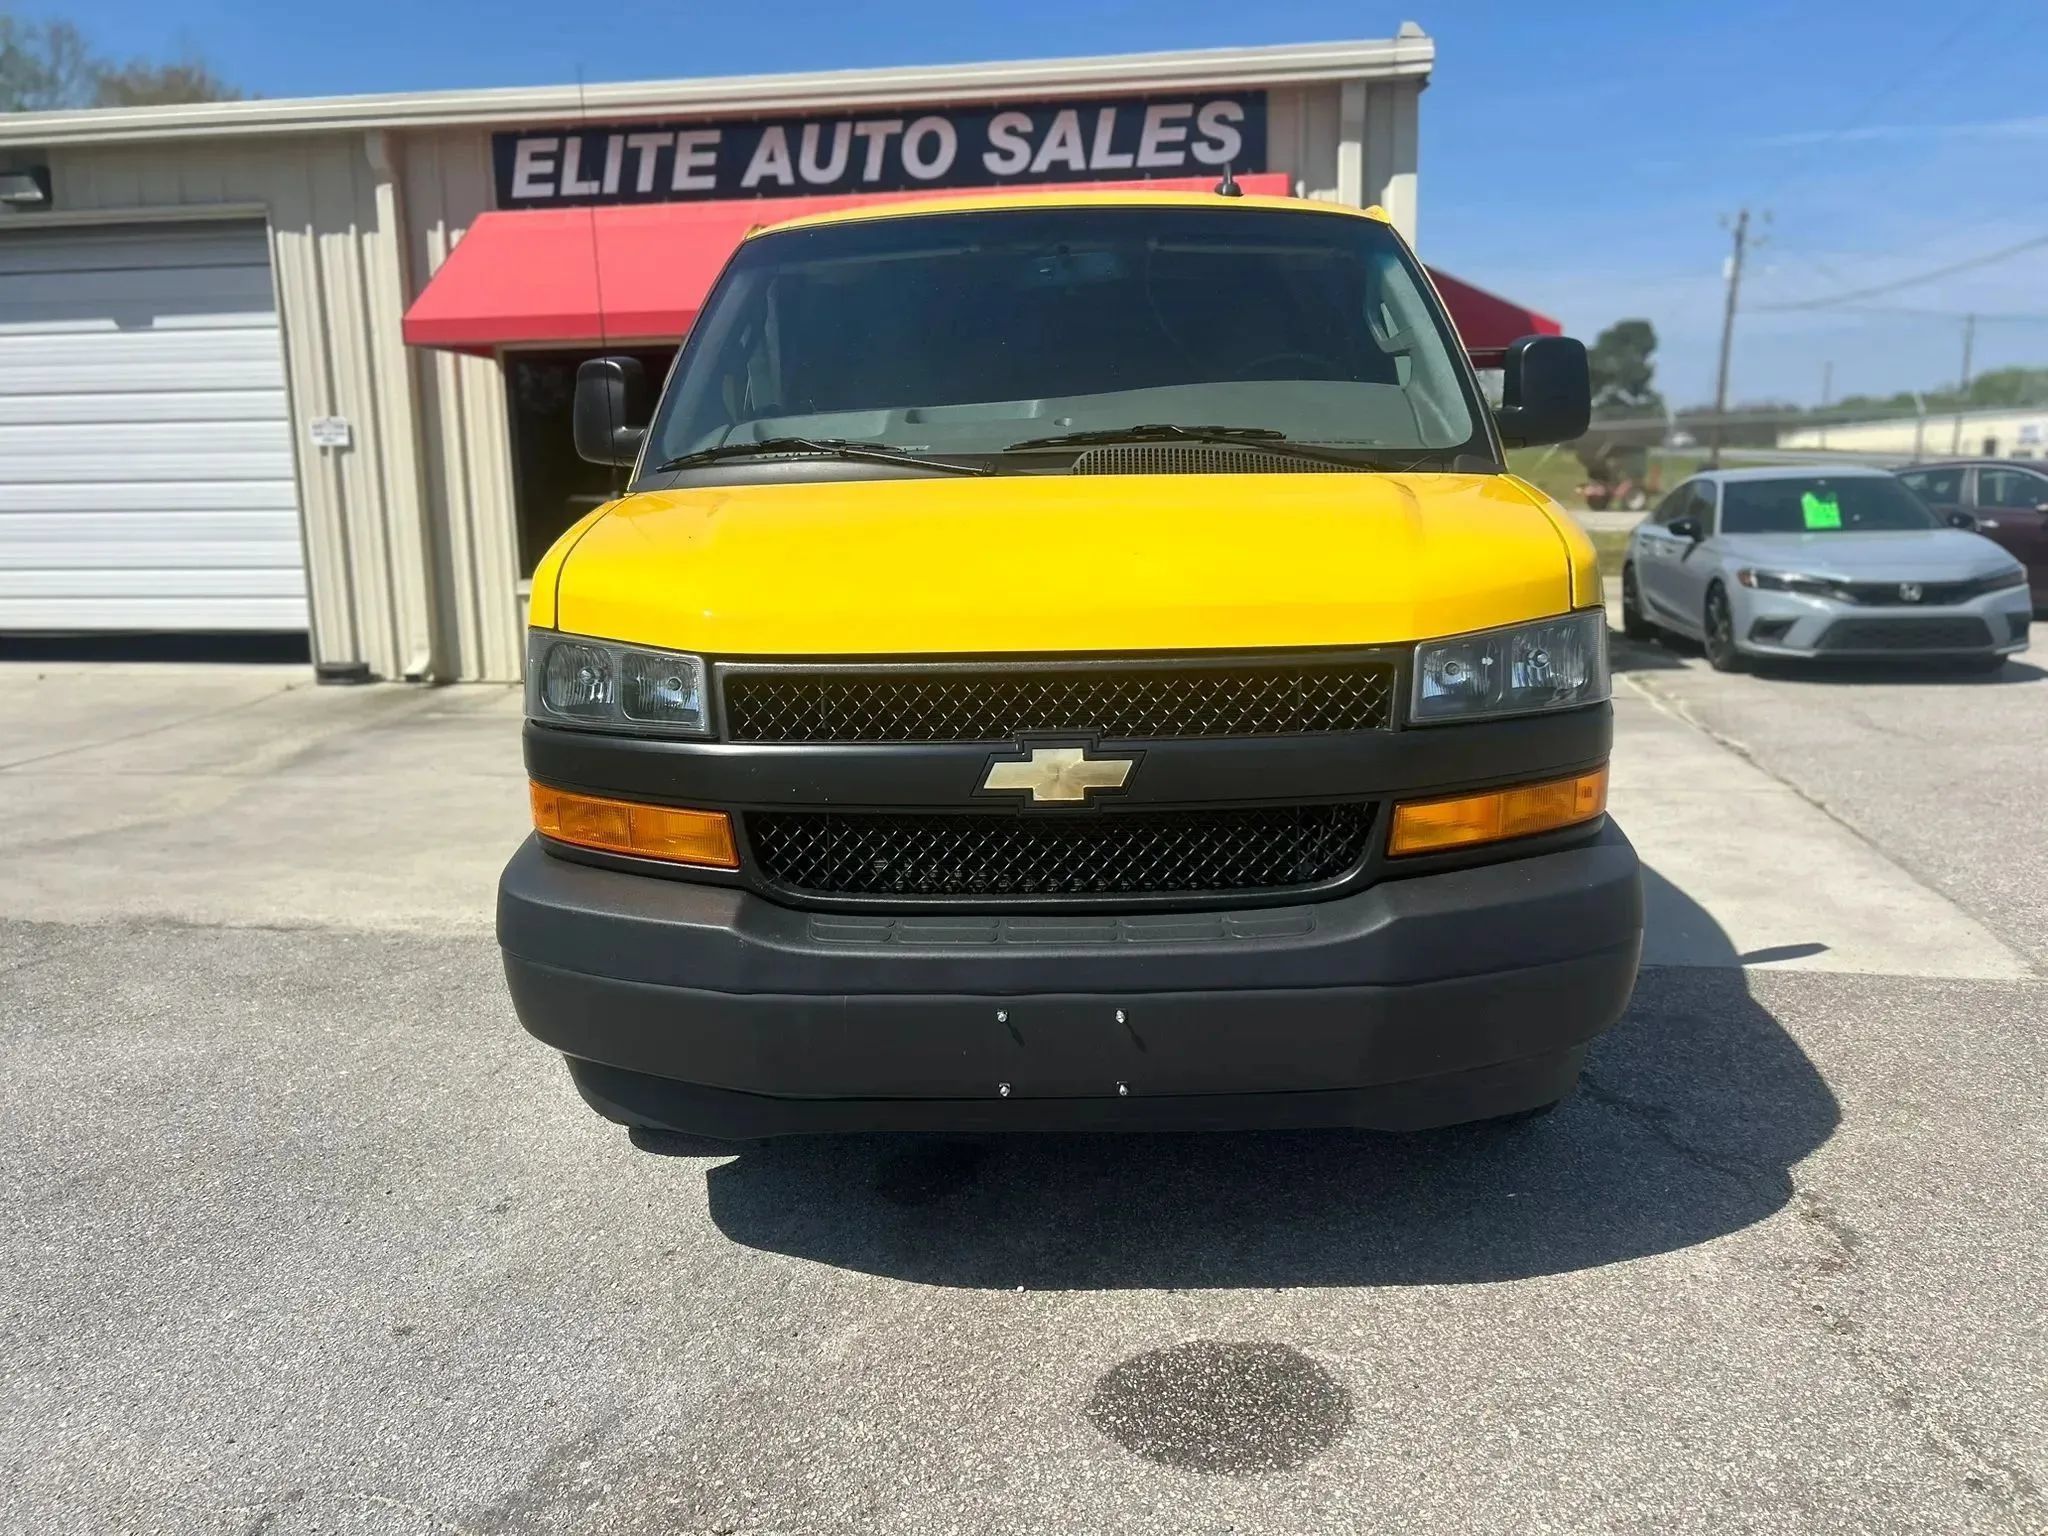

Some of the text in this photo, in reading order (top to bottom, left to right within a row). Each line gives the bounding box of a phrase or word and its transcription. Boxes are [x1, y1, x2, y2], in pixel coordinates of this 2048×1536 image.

[513, 100, 1245, 198] ELITE AUTO SALES
